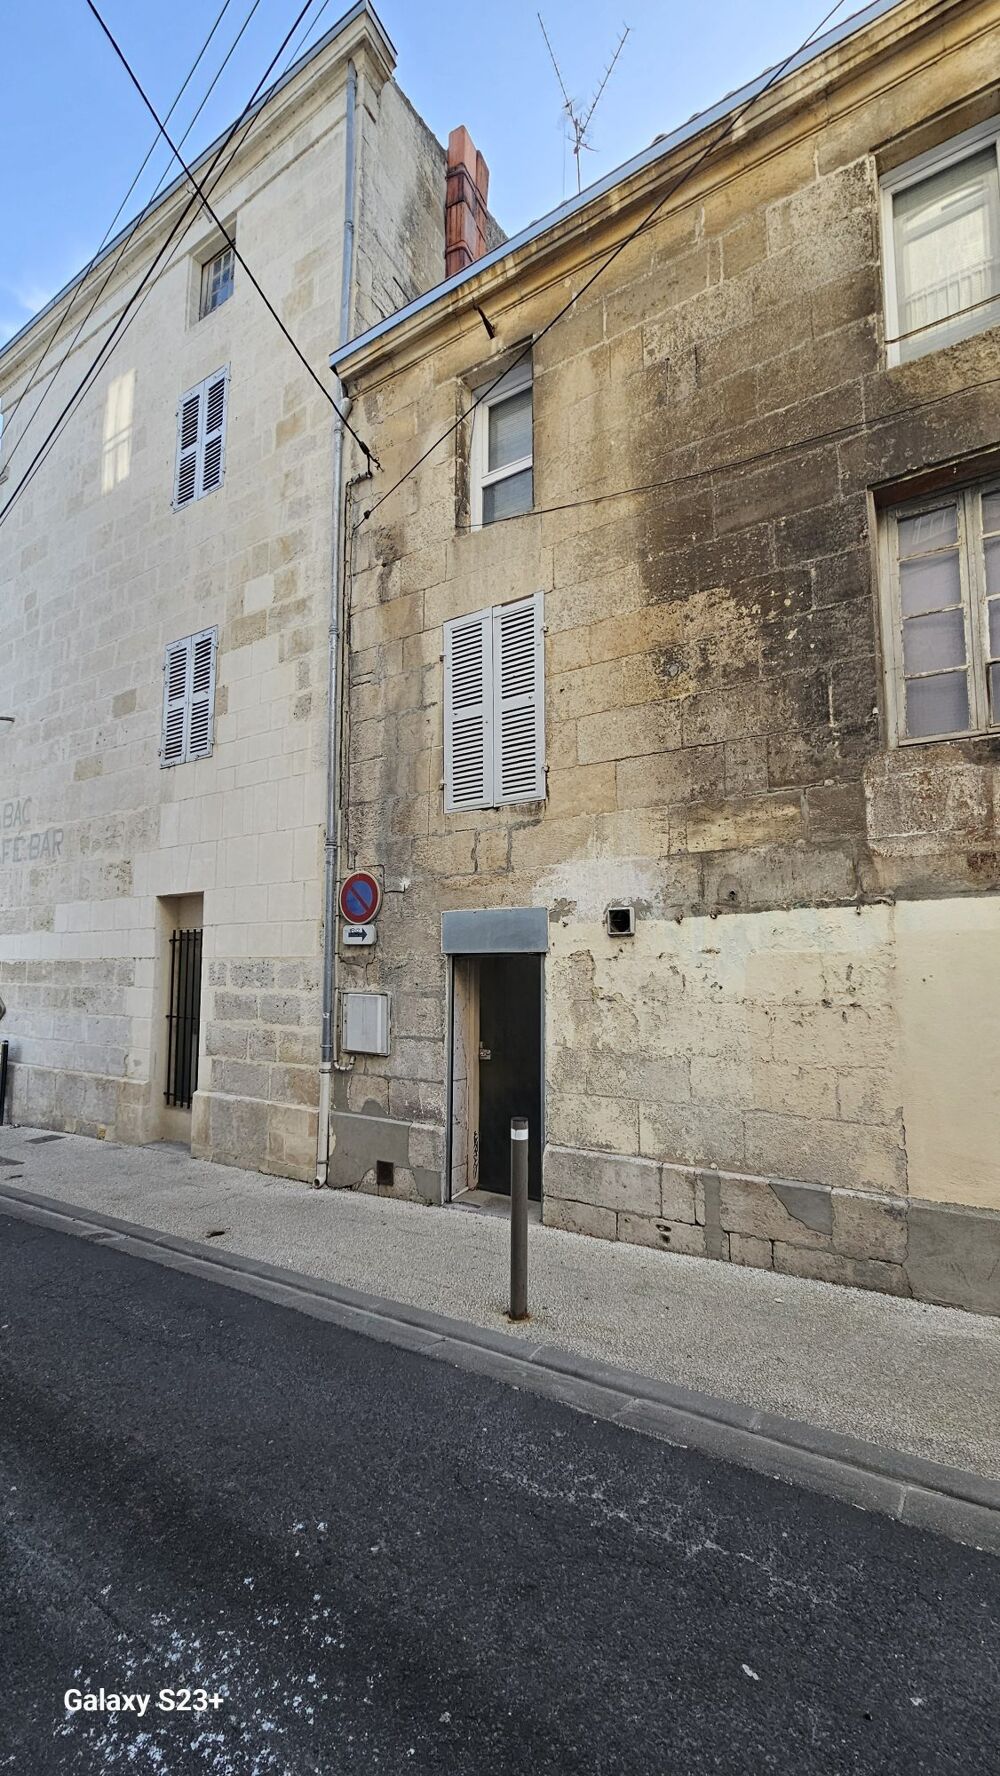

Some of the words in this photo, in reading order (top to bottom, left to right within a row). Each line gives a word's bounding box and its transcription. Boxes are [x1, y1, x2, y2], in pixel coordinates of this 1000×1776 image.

[0, 798, 32, 829] BAC
[0, 830, 26, 865] FÉ
[29, 828, 64, 860] BAR
